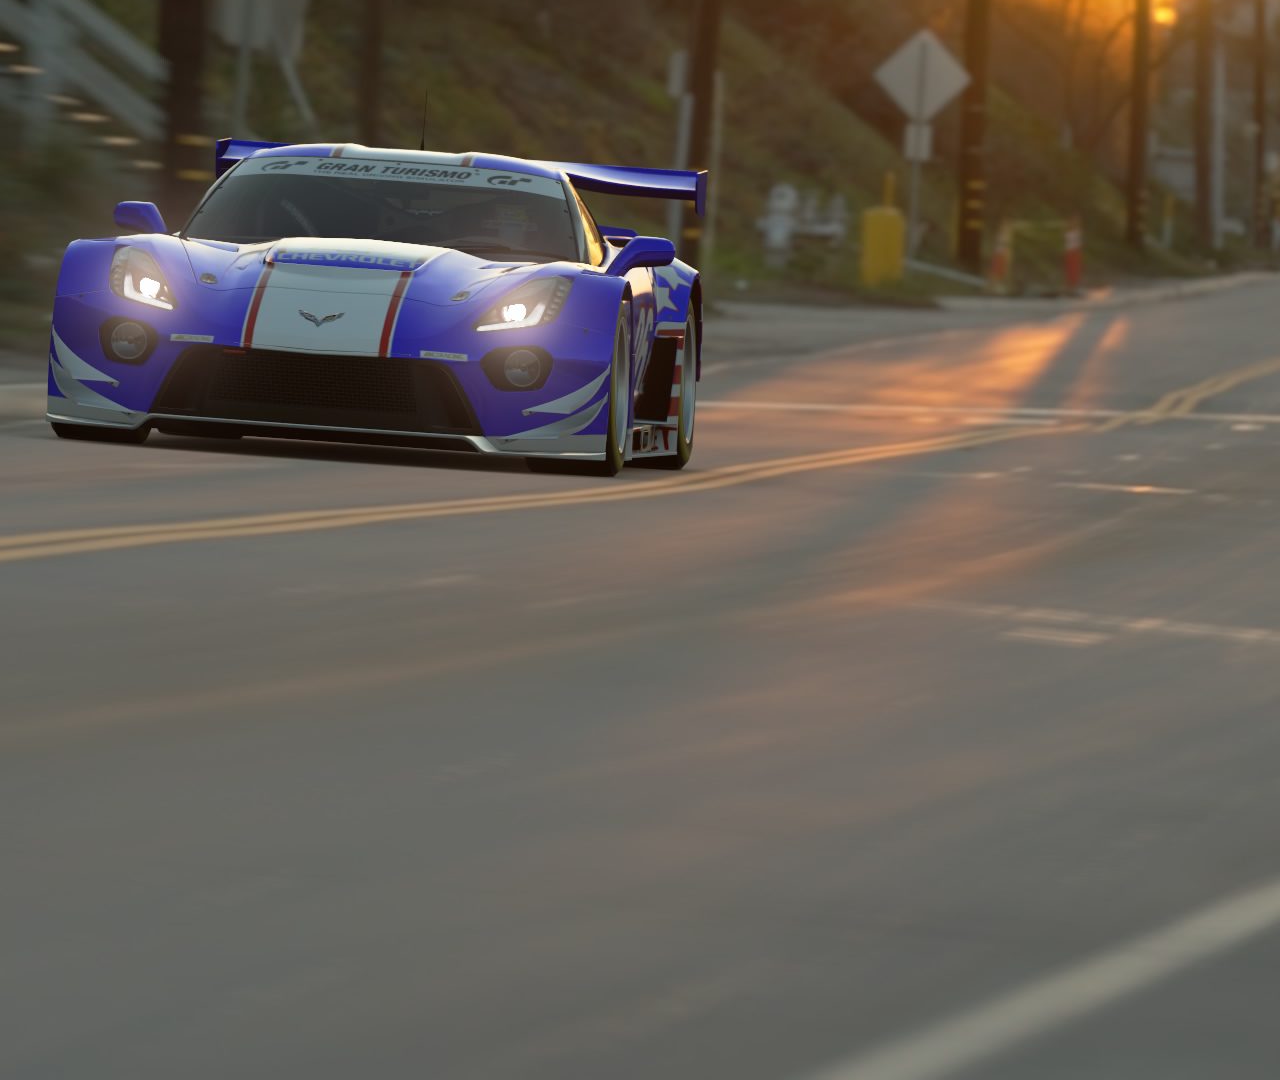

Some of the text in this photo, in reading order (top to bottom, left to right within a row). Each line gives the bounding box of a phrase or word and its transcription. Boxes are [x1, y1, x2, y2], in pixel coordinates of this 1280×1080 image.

[316, 162, 473, 180] GRAN TURISMO
[277, 250, 419, 269] CHEVROLET
